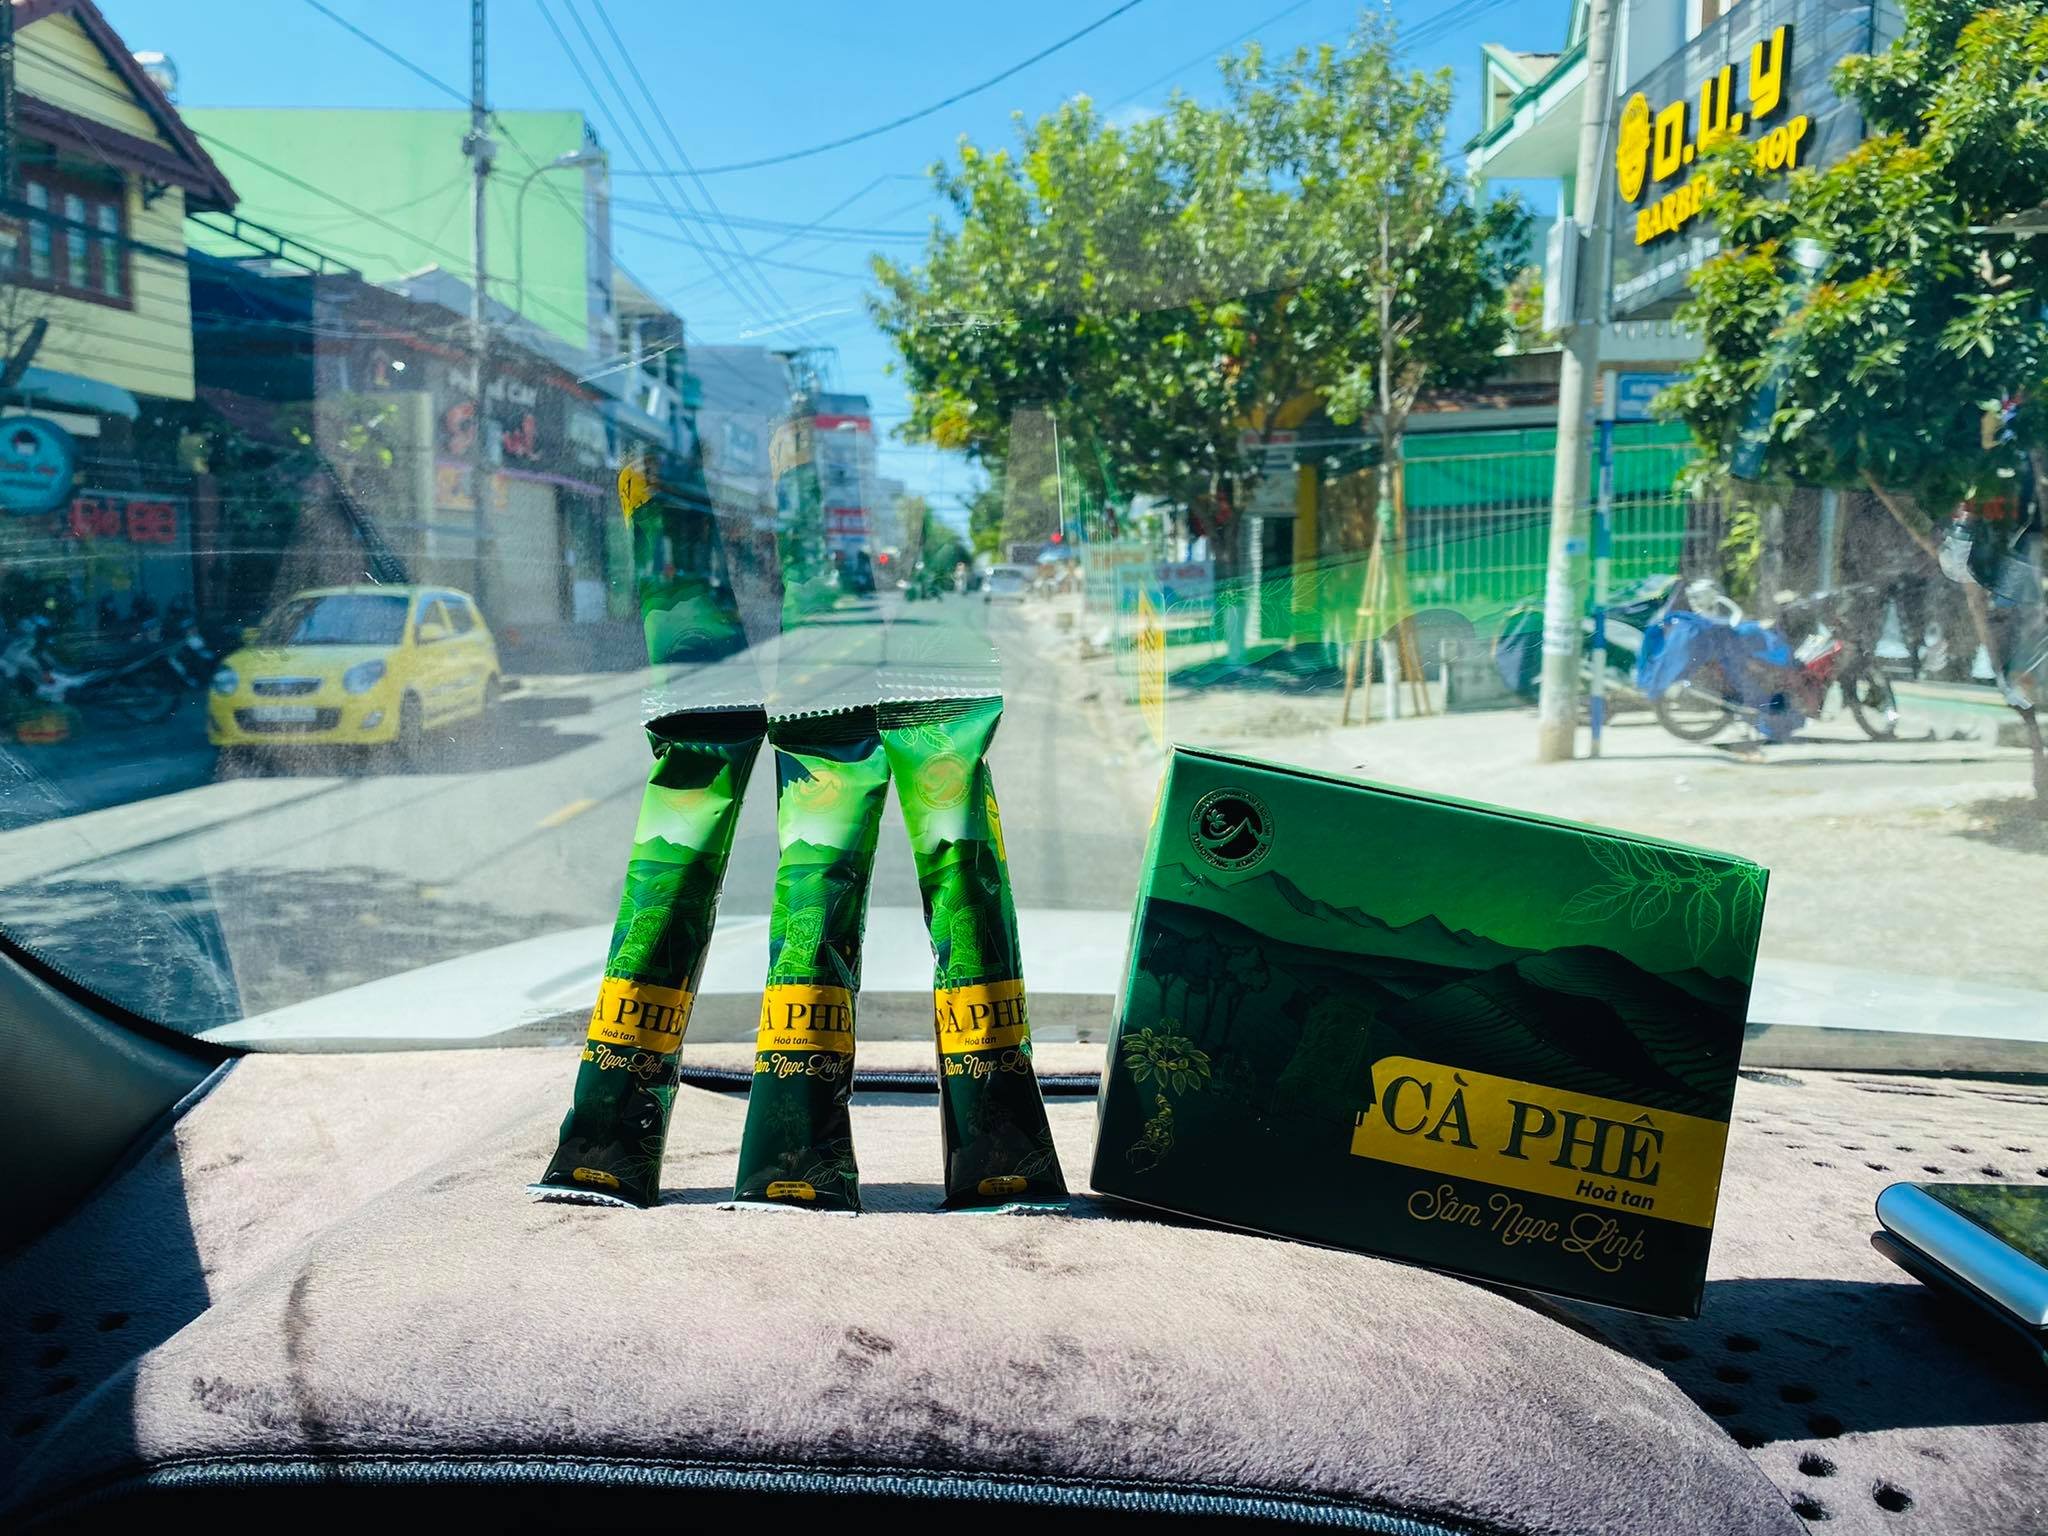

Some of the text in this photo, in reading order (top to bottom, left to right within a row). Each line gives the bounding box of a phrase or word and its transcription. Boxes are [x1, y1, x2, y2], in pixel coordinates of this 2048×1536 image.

[613, 997, 686, 1036] PHÊ
[783, 1001, 853, 1033] PHÊ
[620, 1032, 636, 1042] tan
[793, 1036, 808, 1045] tan
[596, 1044, 627, 1070] Ngọc
[771, 1053, 804, 1079] Ngọc
[1381, 1072, 1664, 1187] CÀ PHÊ
[1575, 1179, 1655, 1210] Hoà tan
[1408, 1184, 1645, 1273] Sâm Ngọc Linh
